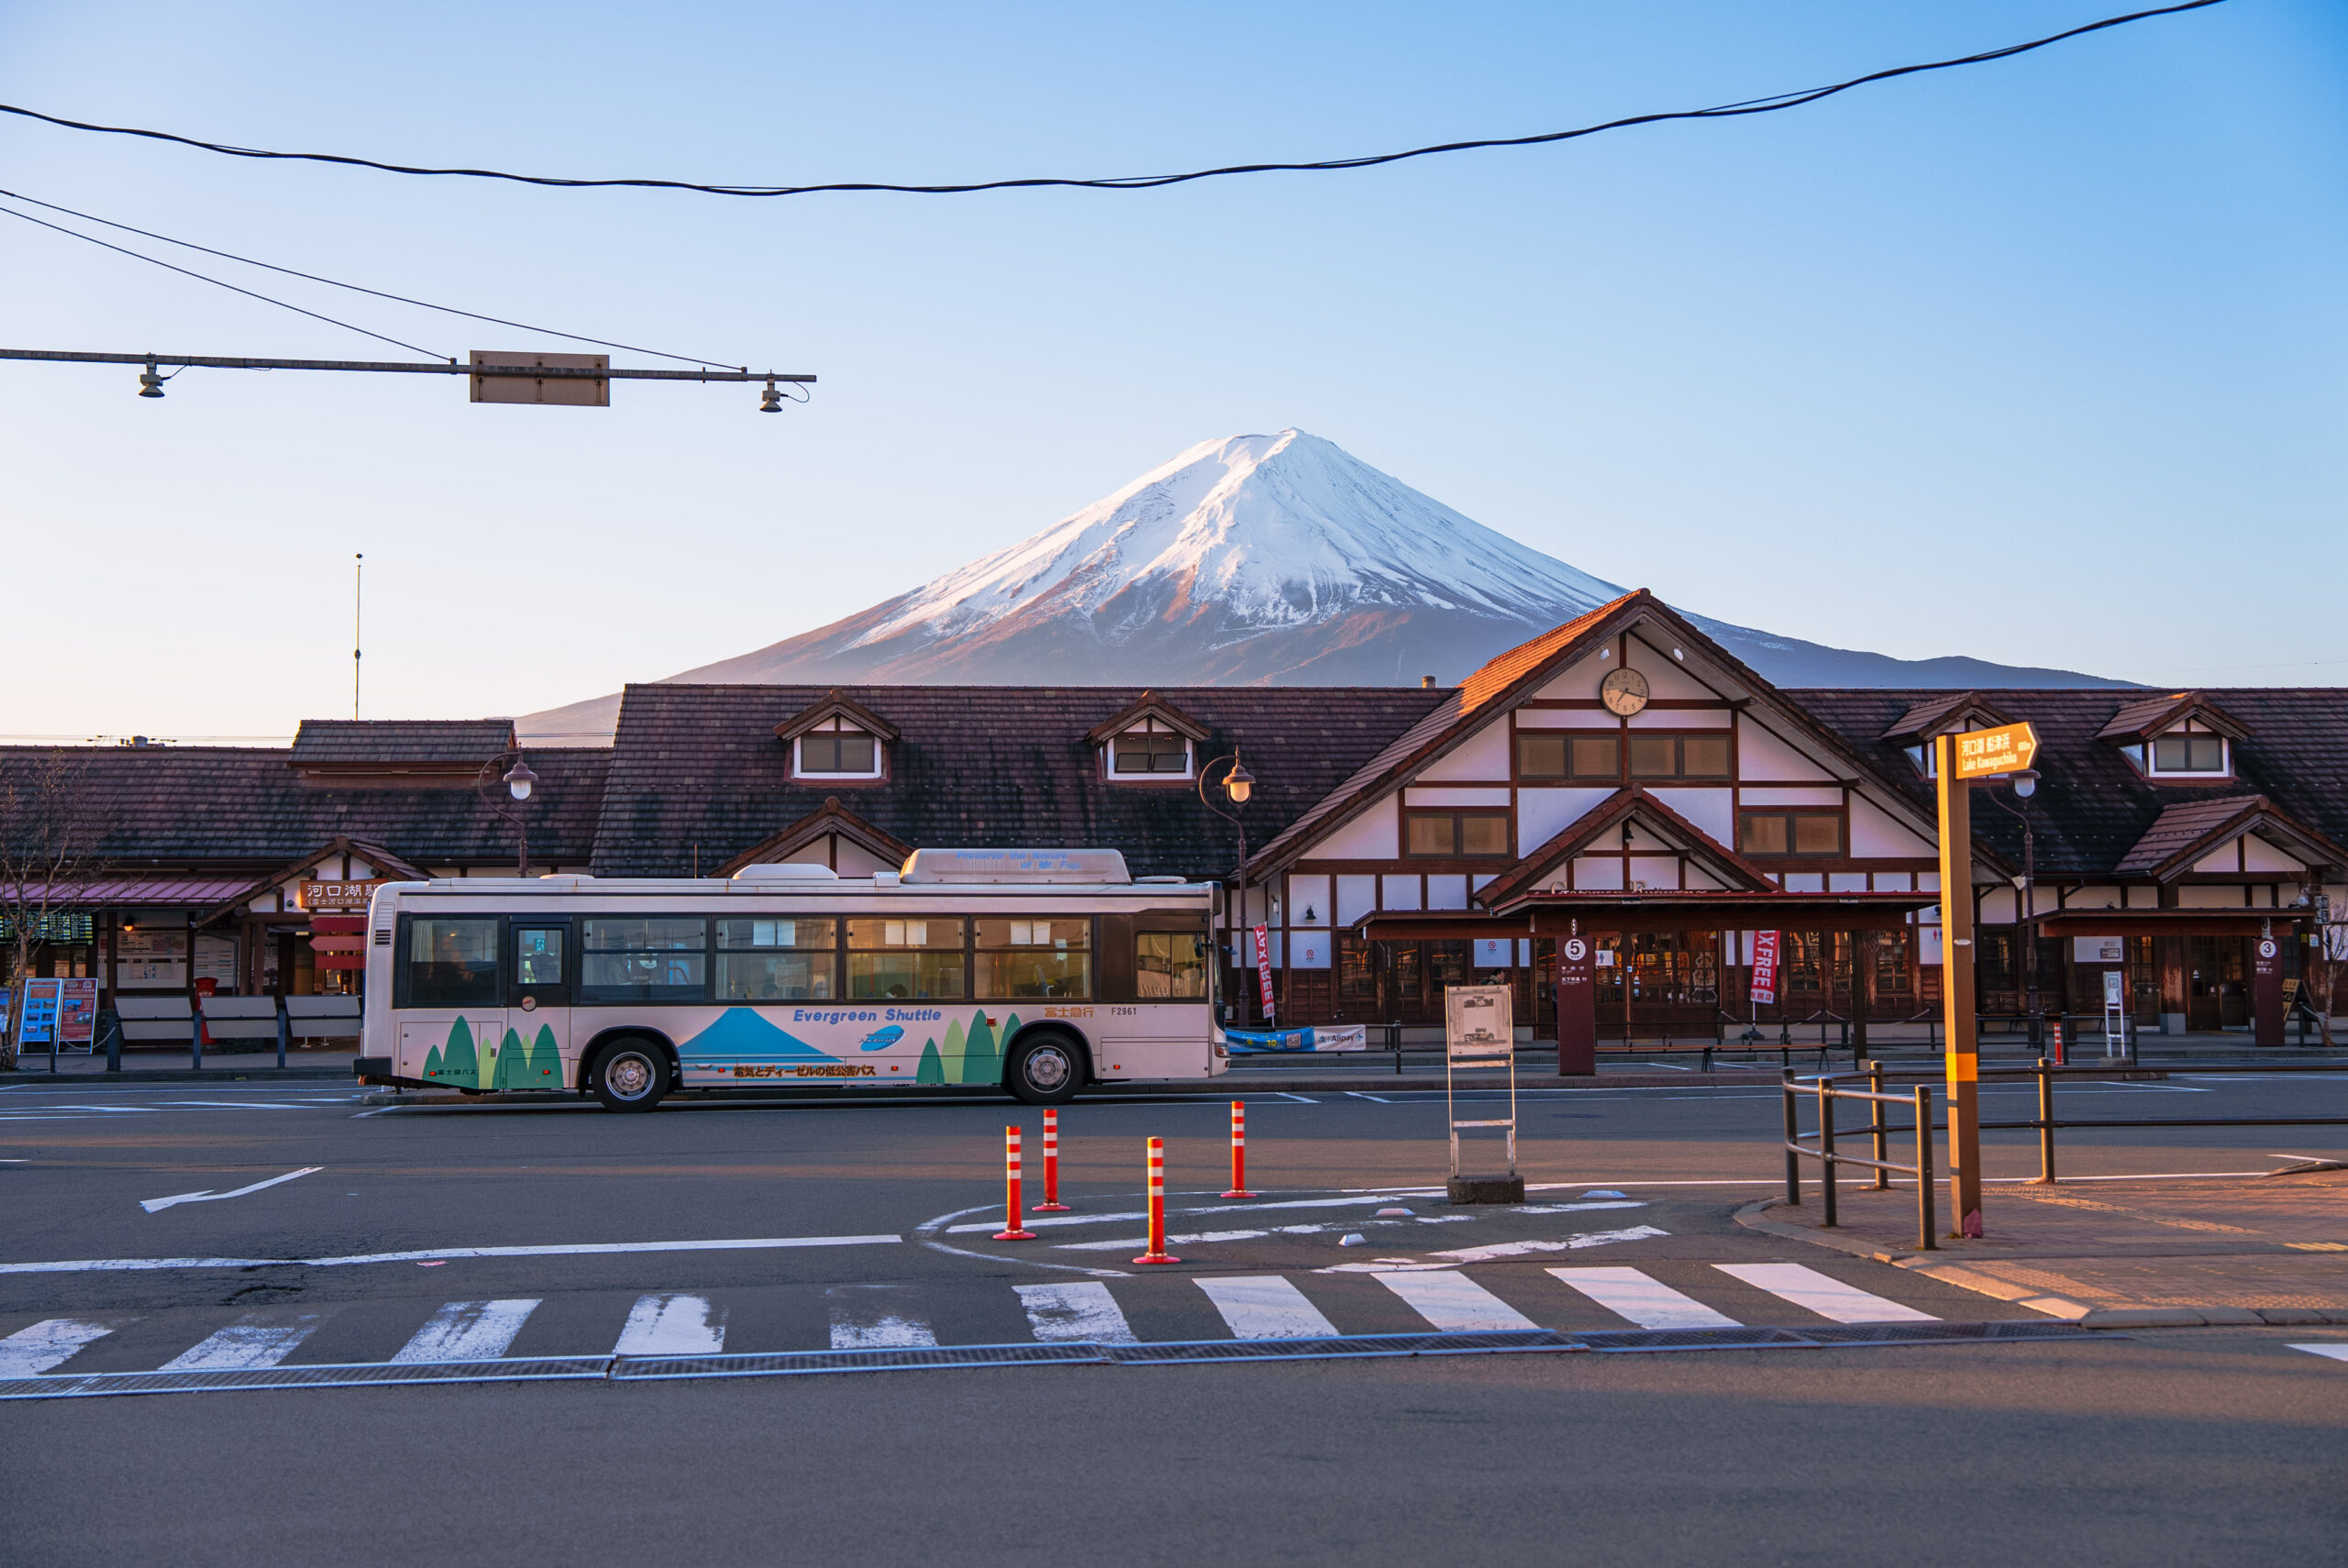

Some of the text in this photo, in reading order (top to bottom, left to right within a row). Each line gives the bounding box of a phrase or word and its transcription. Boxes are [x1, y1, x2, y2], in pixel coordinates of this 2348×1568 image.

[1963, 751, 2017, 771] Lake Kawaguchiko
[1570, 940, 1580, 955] 5
[2264, 942, 2272, 954] 3
[1753, 947, 1774, 988] FREE
[792, 1008, 942, 1025] Evergreen Shuttle
[1044, 1006, 1094, 1018] 富士急行
[1111, 1007, 1137, 1015] F2961
[733, 1065, 877, 1077] 電気とディーゼルの低公害バス
